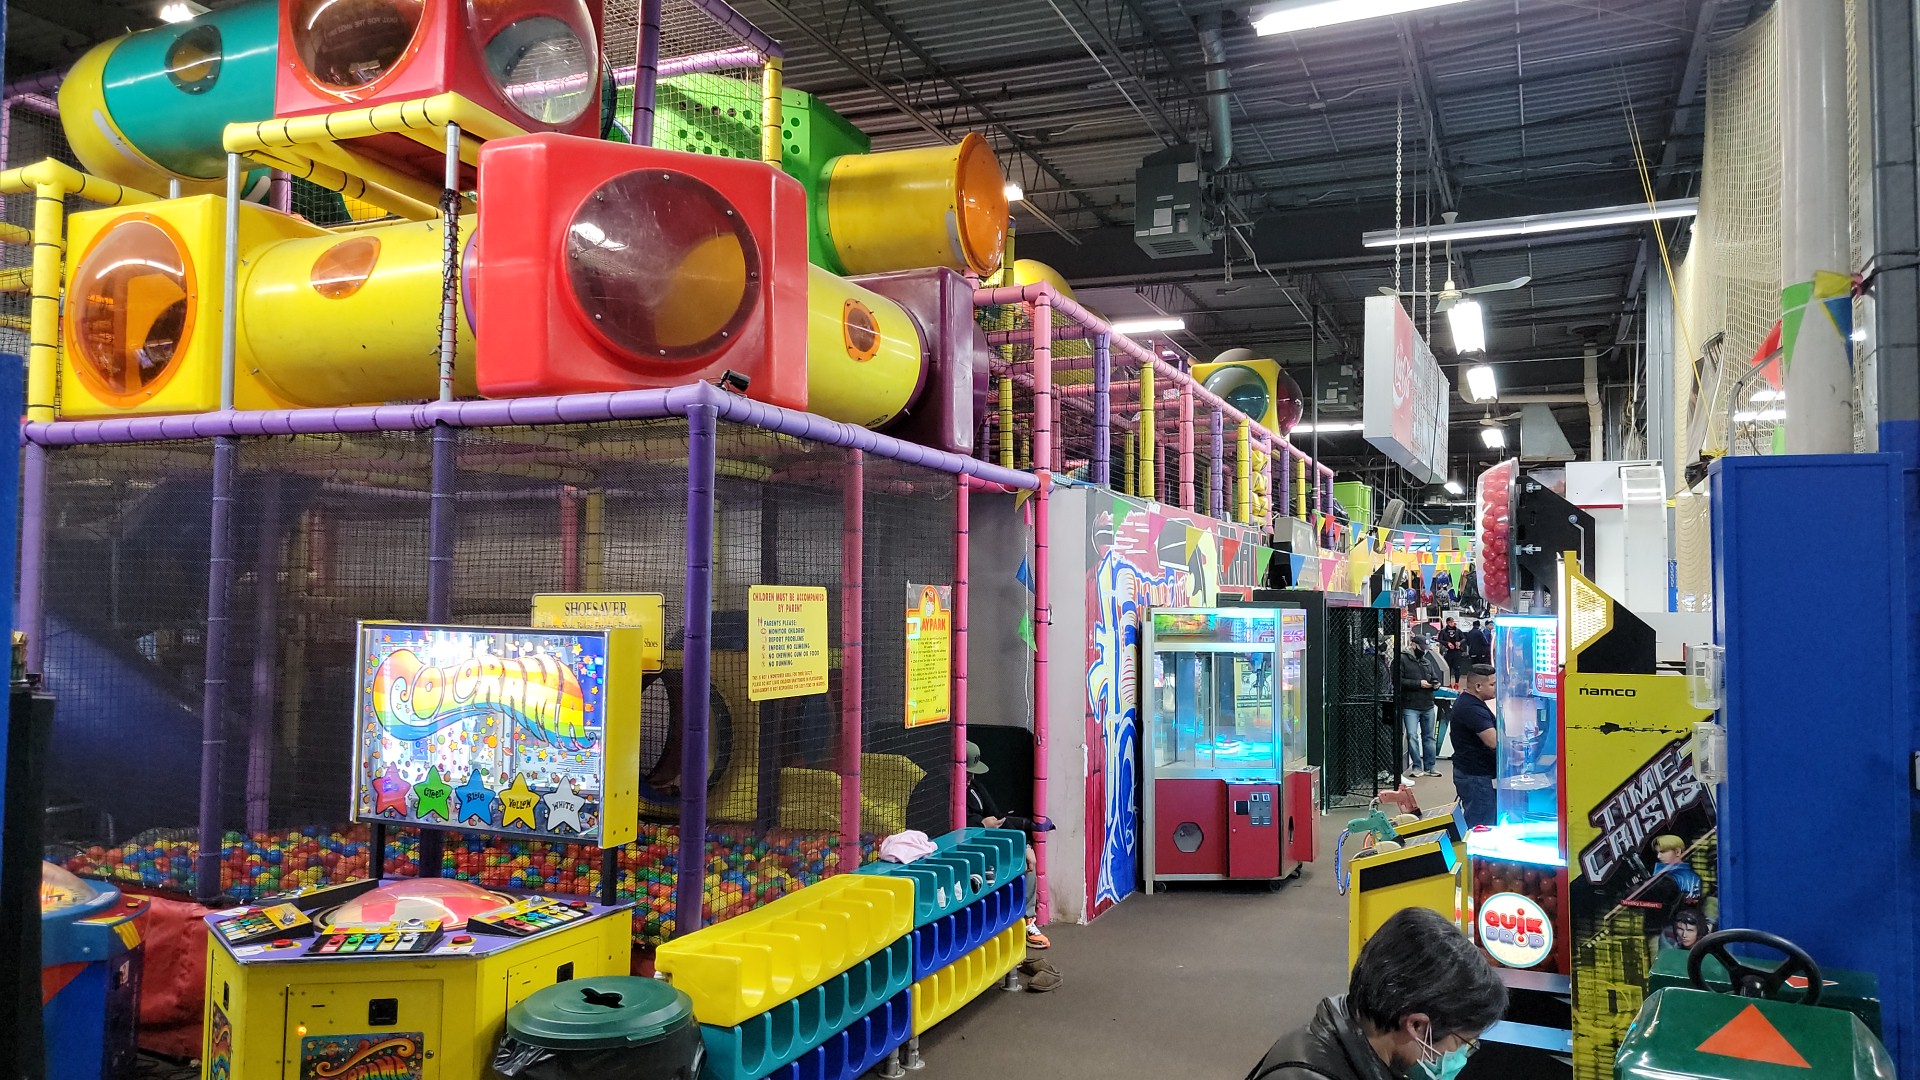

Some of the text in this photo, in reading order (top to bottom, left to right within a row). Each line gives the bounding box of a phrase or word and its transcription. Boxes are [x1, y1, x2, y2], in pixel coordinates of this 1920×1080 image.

[753, 593, 824, 601] CHILDREN MUST BE ACCOMPANIED
[564, 601, 627, 616] SHOESAVER
[778, 604, 802, 612] BY PARENT
[764, 619, 781, 627] PARENTS
[643, 638, 658, 648] Shoes
[1579, 687, 1636, 697] namco
[1594, 751, 1679, 831] TIME
[551, 801, 575, 812] WHITE
[1584, 766, 1703, 882] CRISIS
[1486, 925, 1544, 949] DROP
